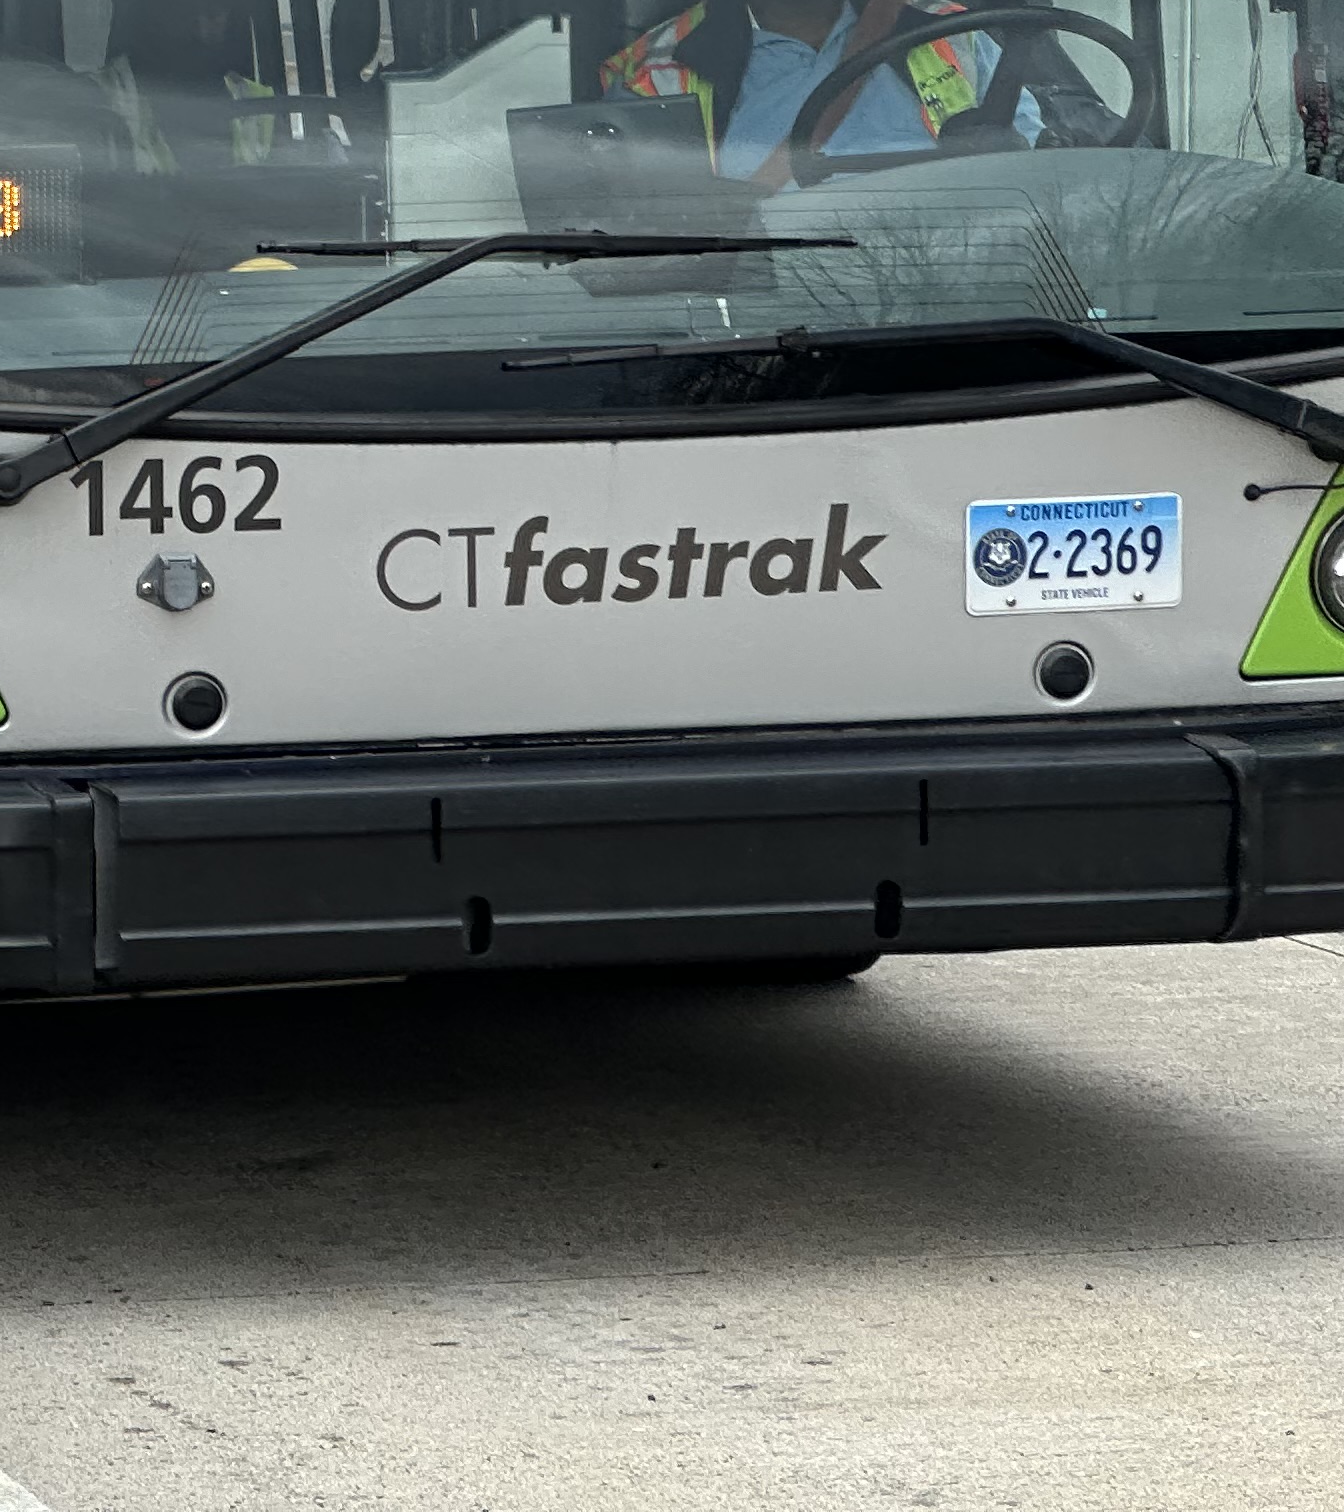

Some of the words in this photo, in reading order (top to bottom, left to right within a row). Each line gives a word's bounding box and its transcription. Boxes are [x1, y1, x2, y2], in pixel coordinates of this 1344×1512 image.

[69, 454, 282, 536] 1462
[1020, 500, 1130, 521] CONNECTICUT
[376, 503, 889, 611] CTfastrak
[1041, 587, 1070, 601] STATE
[1071, 587, 1109, 600] VEHICLE
